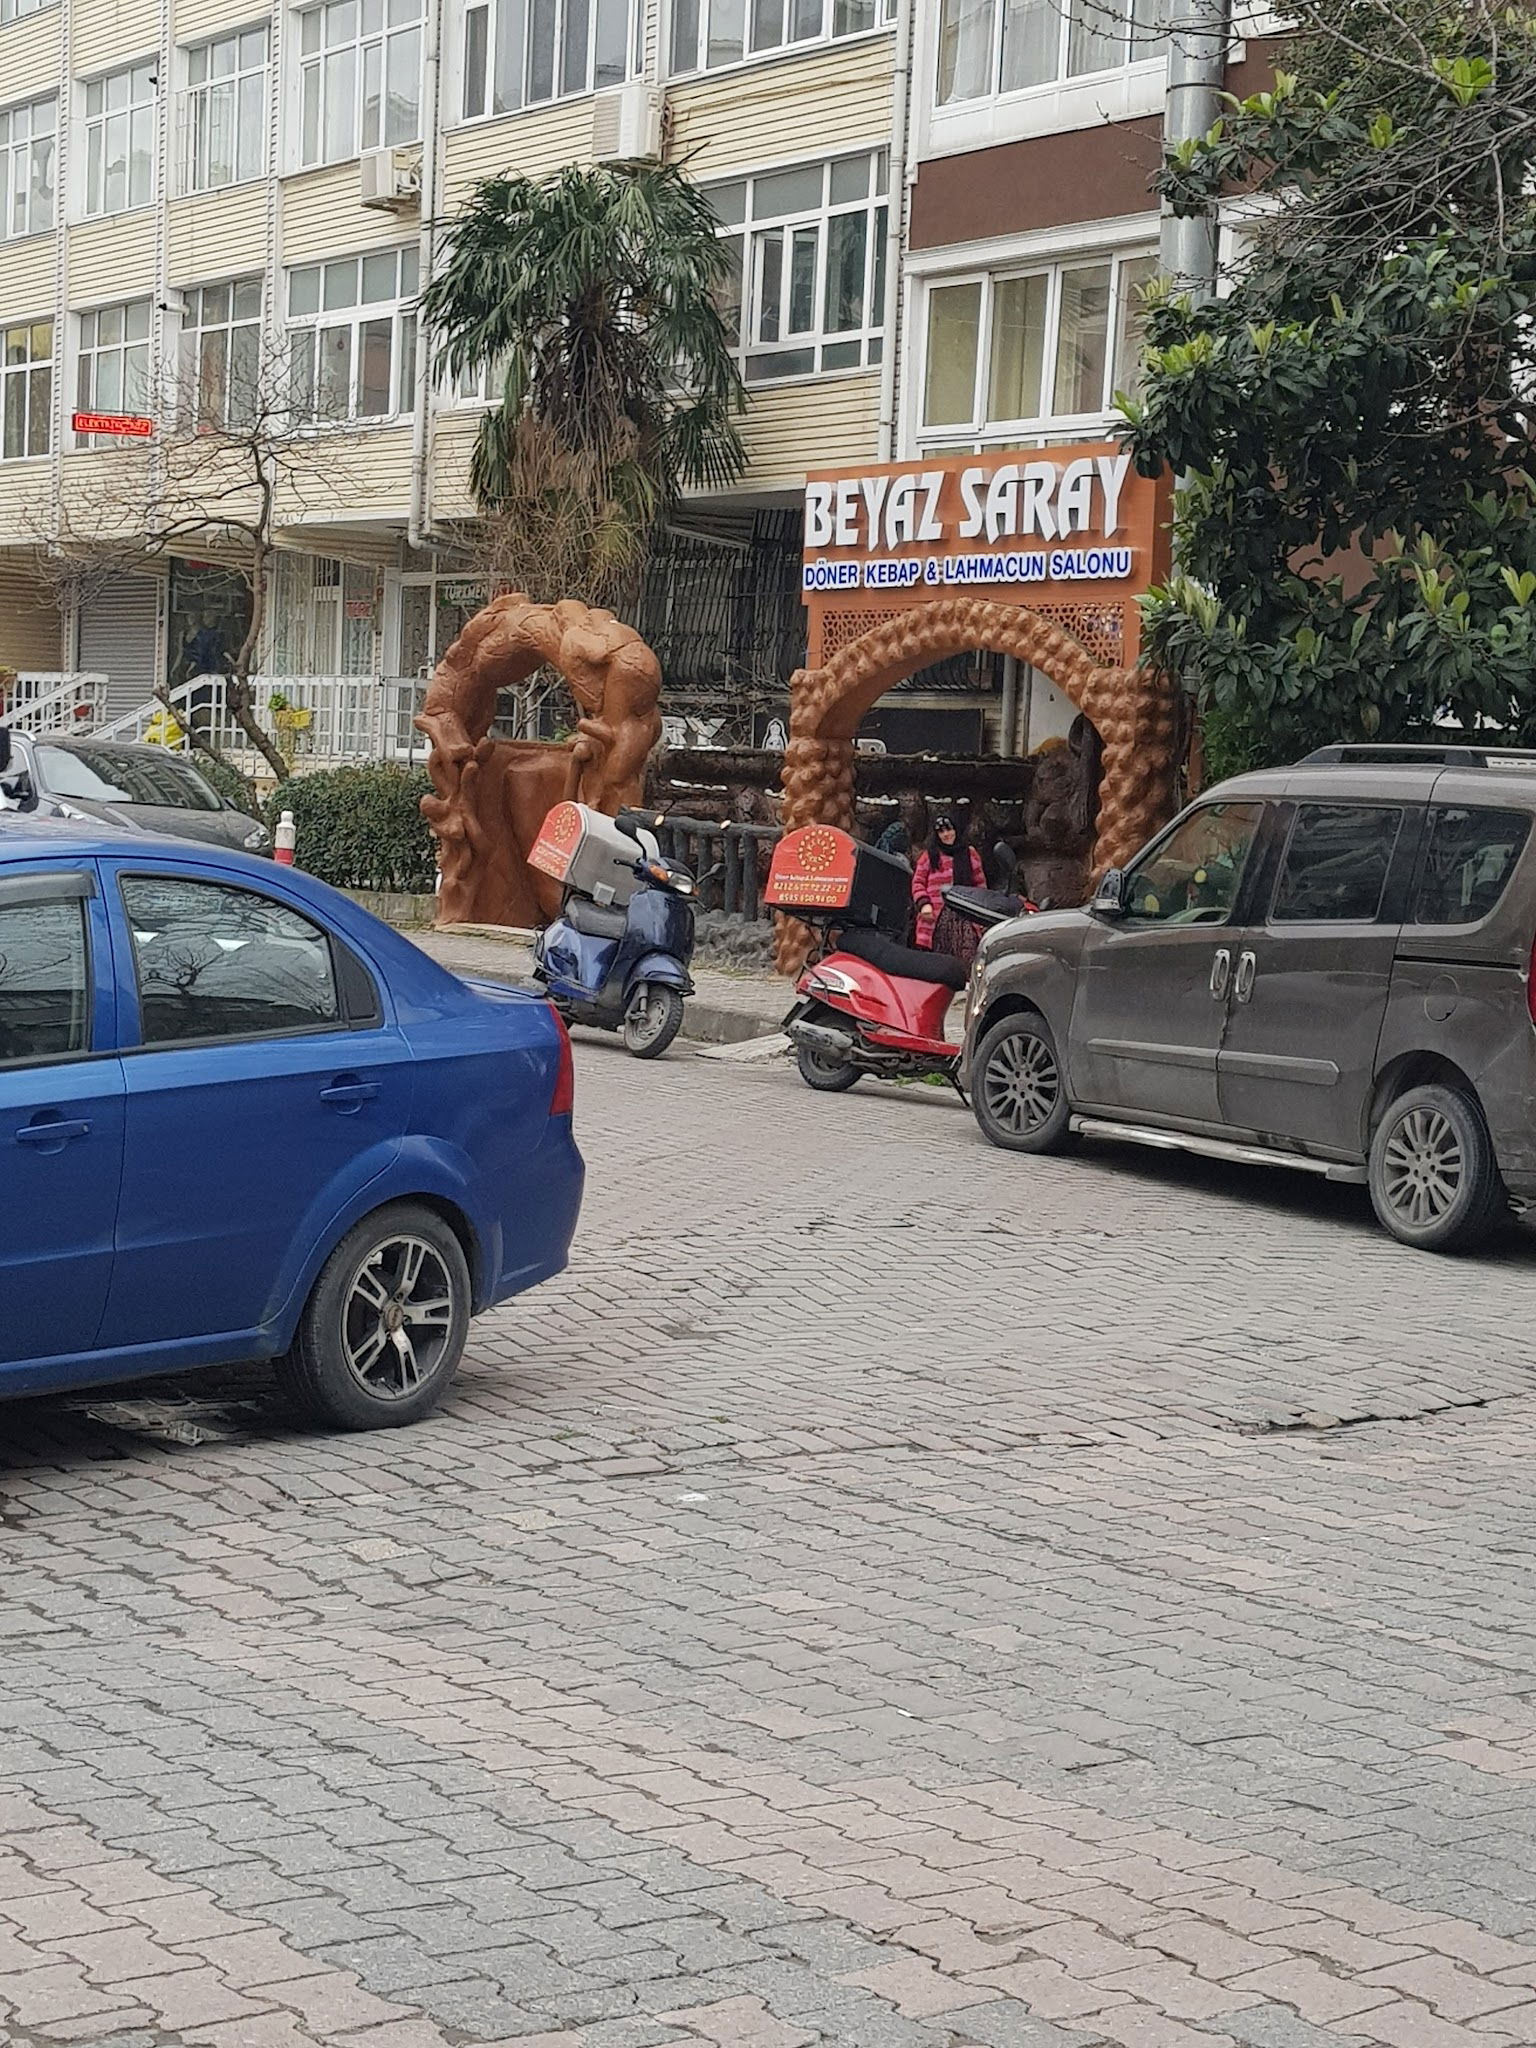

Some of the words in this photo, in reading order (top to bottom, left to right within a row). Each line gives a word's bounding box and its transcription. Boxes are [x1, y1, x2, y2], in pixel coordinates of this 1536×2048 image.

[805, 471, 945, 551] BEYAZ
[959, 454, 1133, 545] SARAY
[804, 559, 858, 587] DÖNER
[865, 561, 919, 584] KEBAP
[926, 561, 936, 581] &
[945, 555, 1044, 580] LAHMACUN
[1051, 550, 1130, 577] SALONU
